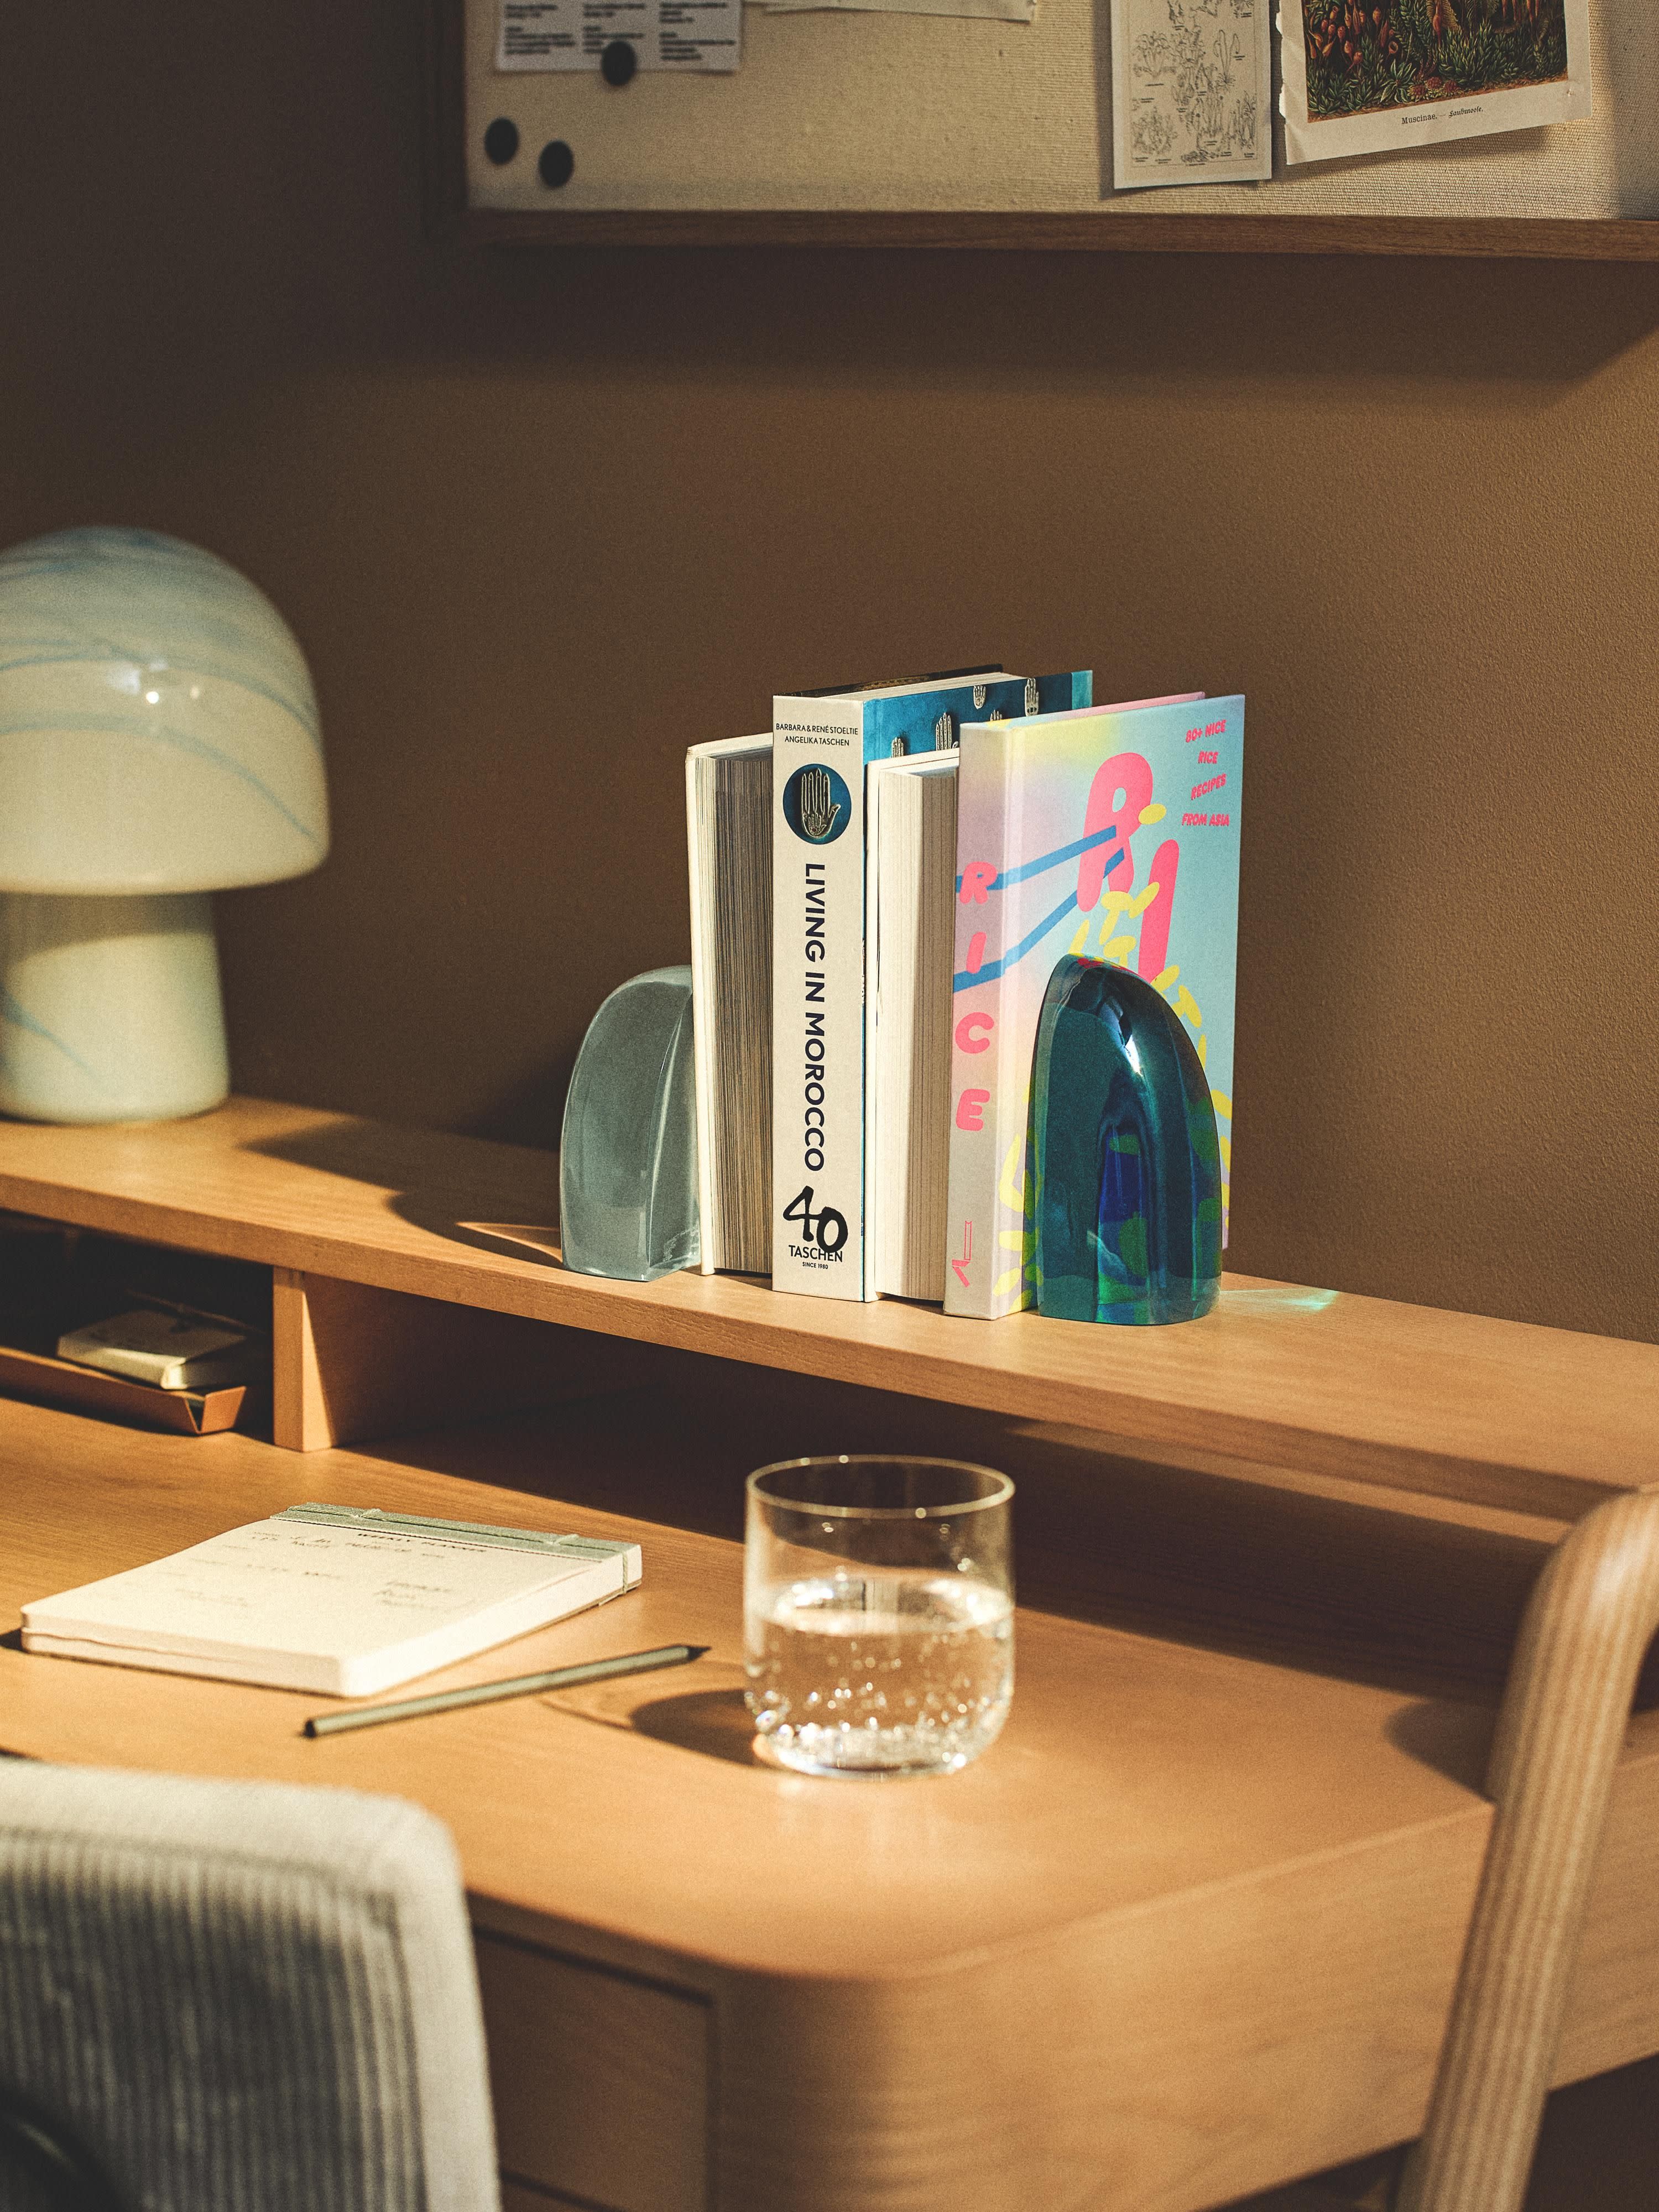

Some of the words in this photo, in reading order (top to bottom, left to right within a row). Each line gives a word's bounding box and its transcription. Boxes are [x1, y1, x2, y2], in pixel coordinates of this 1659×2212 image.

[1401, 114, 1437, 124] Muscinae.
[776, 723, 806, 732] BARBARA
[812, 724, 830, 733] RENÉ
[830, 726, 858, 735] STOELTIE
[784, 735, 818, 745] ANGELIKA
[818, 738, 849, 746] TASCHEN
[1186, 728, 1203, 743] 80+
[1205, 719, 1227, 737] NICE
[1198, 751, 1219, 764] RICE
[1191, 773, 1227, 800] RECIPES
[1182, 813, 1208, 826] FROM
[1209, 813, 1230, 826] ASIA
[805, 863, 825, 962] LIVING
[805, 972, 825, 1003] IN
[955, 860, 998, 1132] RICE
[805, 1011, 825, 1172] MOROCCO
[782, 1185, 848, 1253] 40
[788, 1244, 843, 1262] TASCHEN
